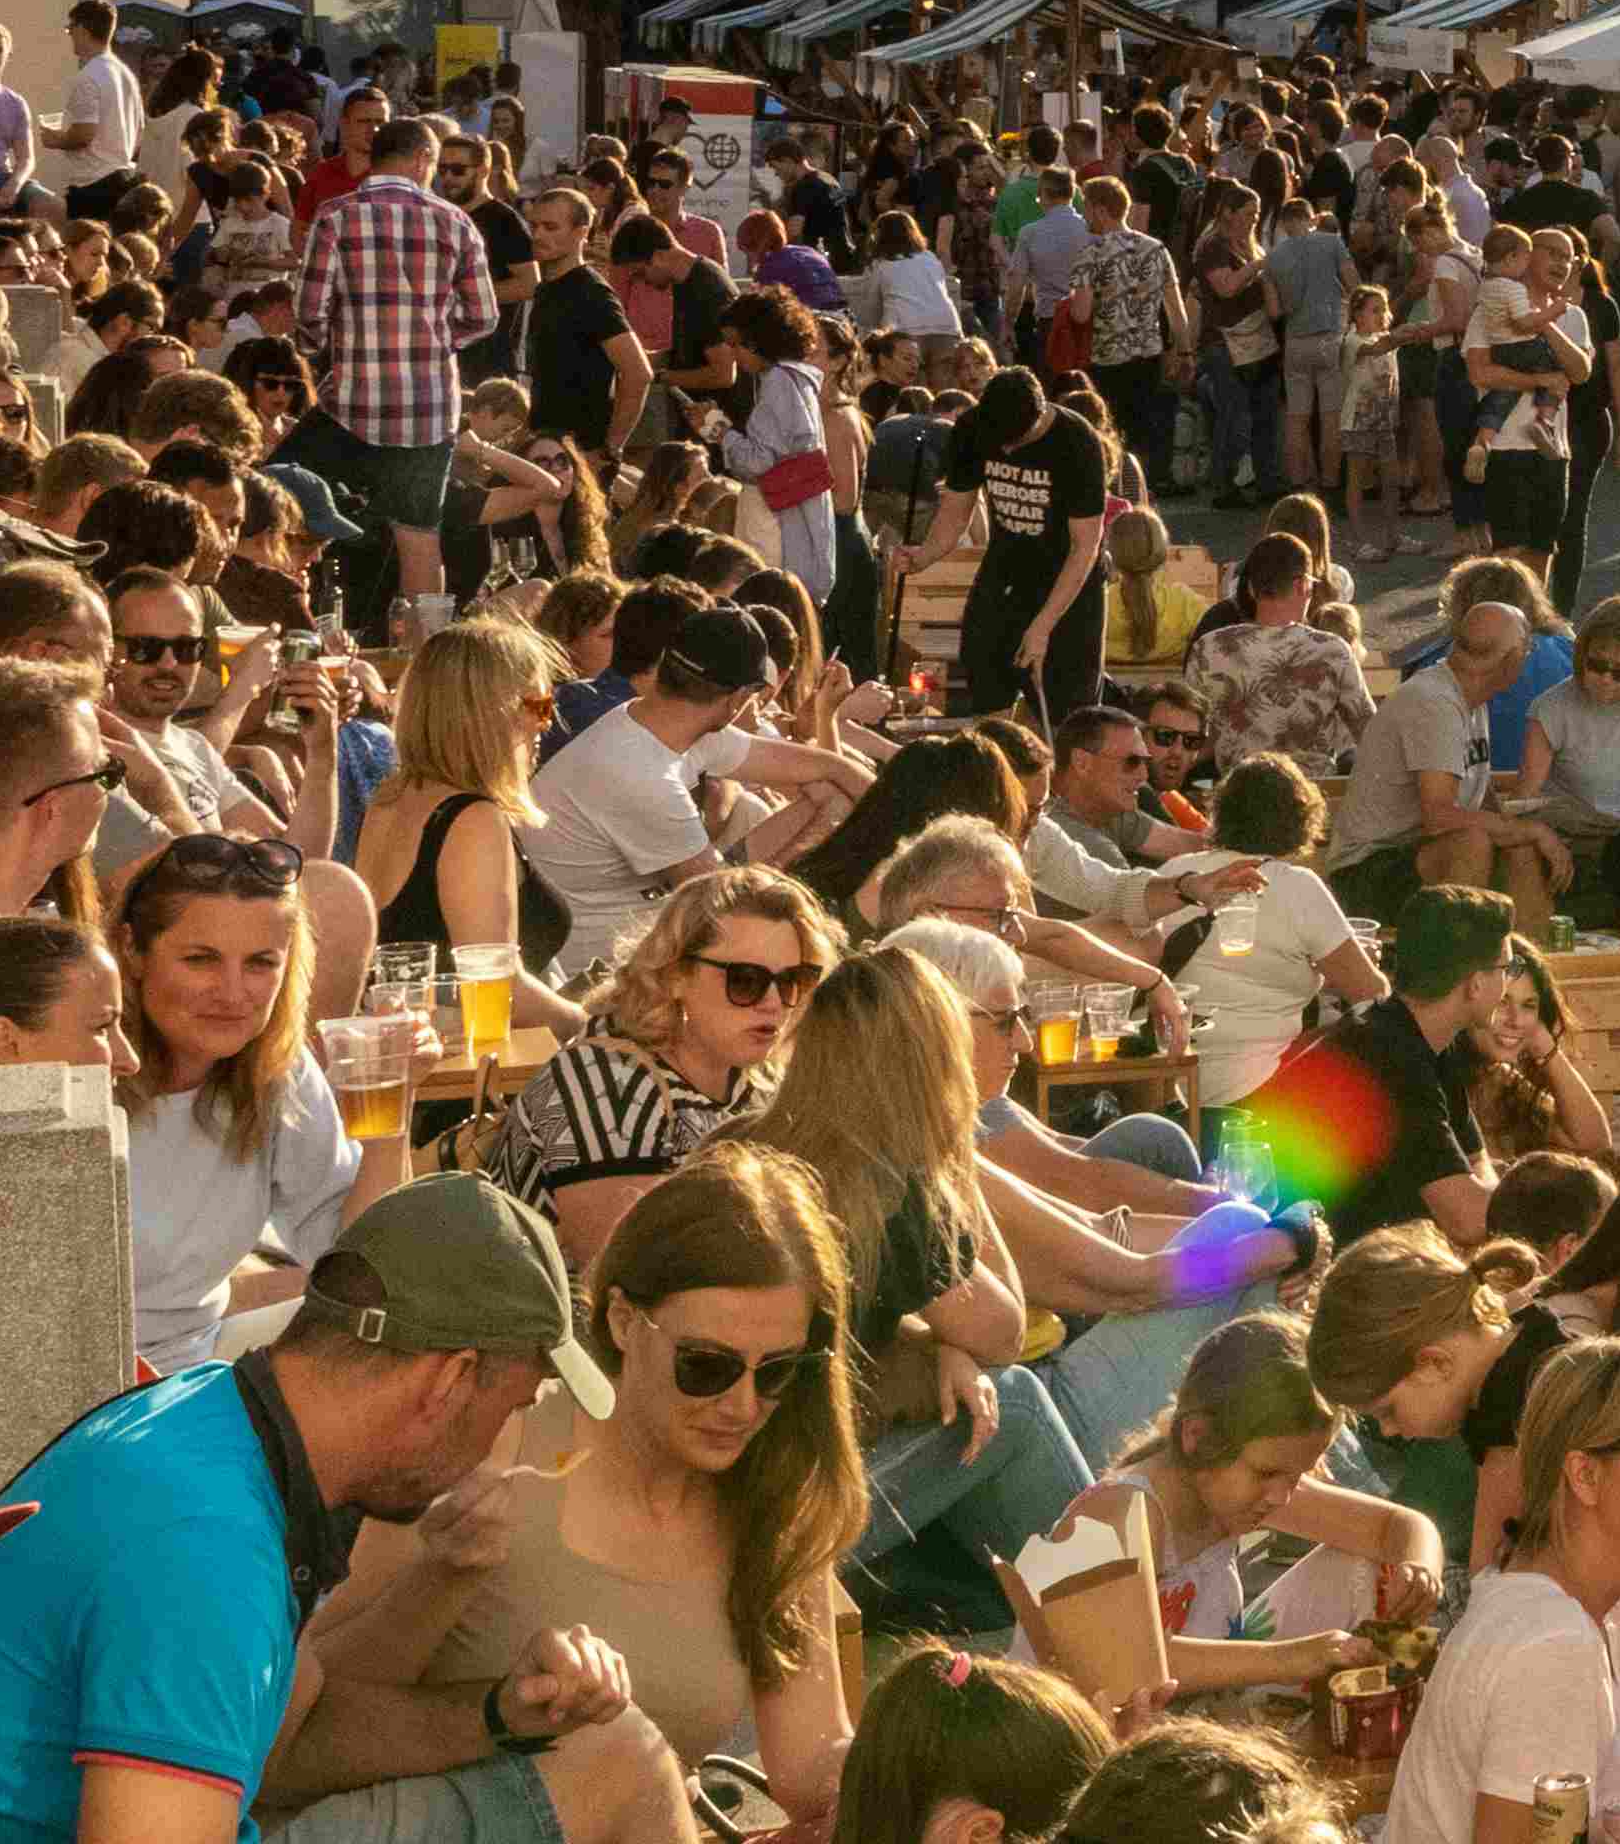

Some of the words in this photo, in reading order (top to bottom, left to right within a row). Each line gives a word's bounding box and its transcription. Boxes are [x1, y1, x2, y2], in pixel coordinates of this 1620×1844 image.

[984, 460, 1021, 481] NOT
[1021, 468, 1053, 486] ALL
[986, 479, 1050, 504] HEROES
[992, 498, 1045, 521] WEAR
